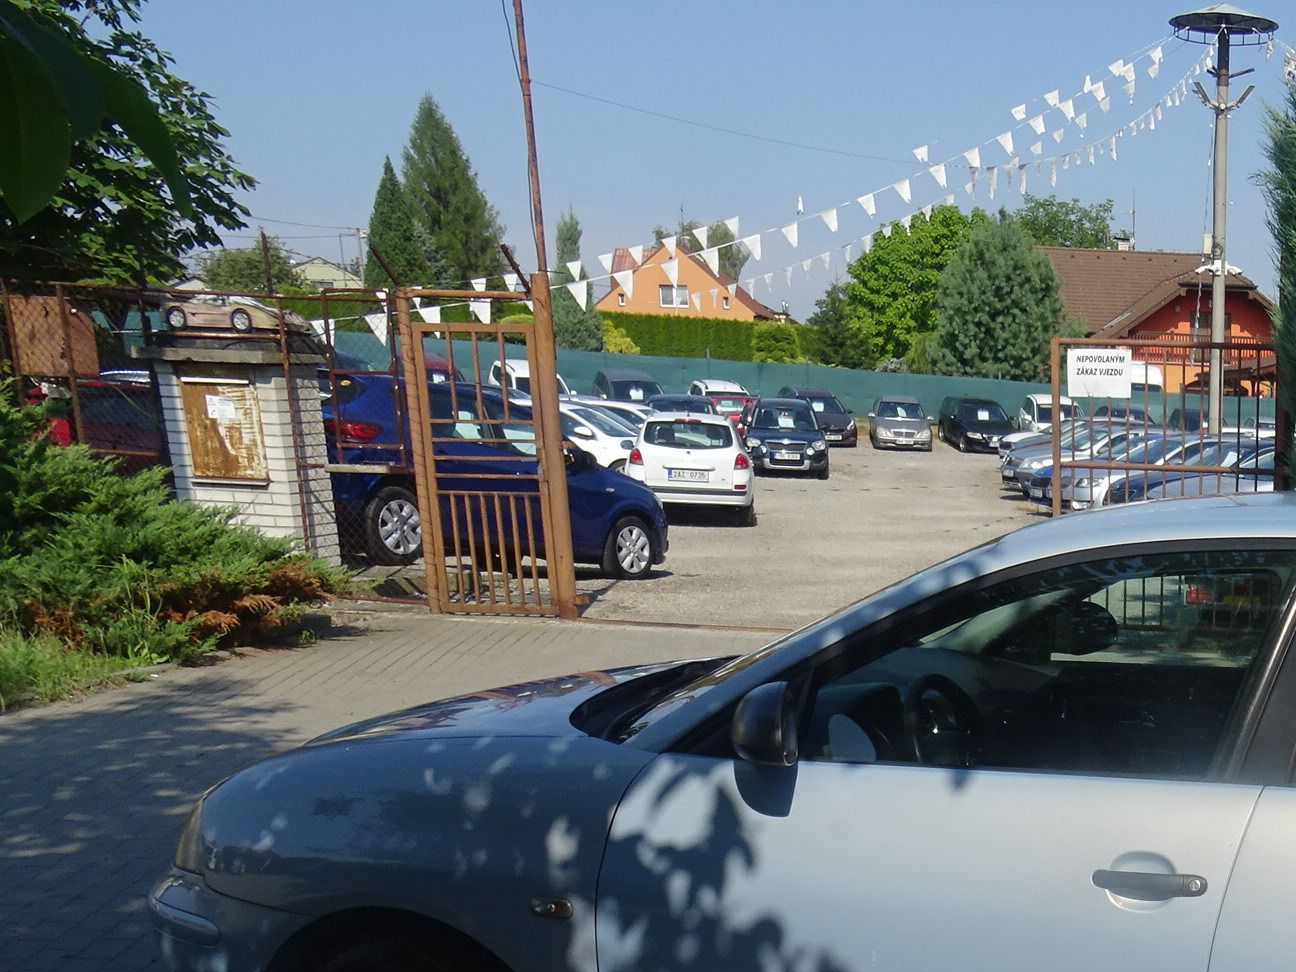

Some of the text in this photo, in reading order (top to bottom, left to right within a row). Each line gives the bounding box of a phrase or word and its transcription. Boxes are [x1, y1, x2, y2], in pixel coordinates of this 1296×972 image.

[1076, 354, 1125, 363] NEPOVOLANÝM
[1076, 366, 1124, 376] ZÁKAZ VJEZDU
